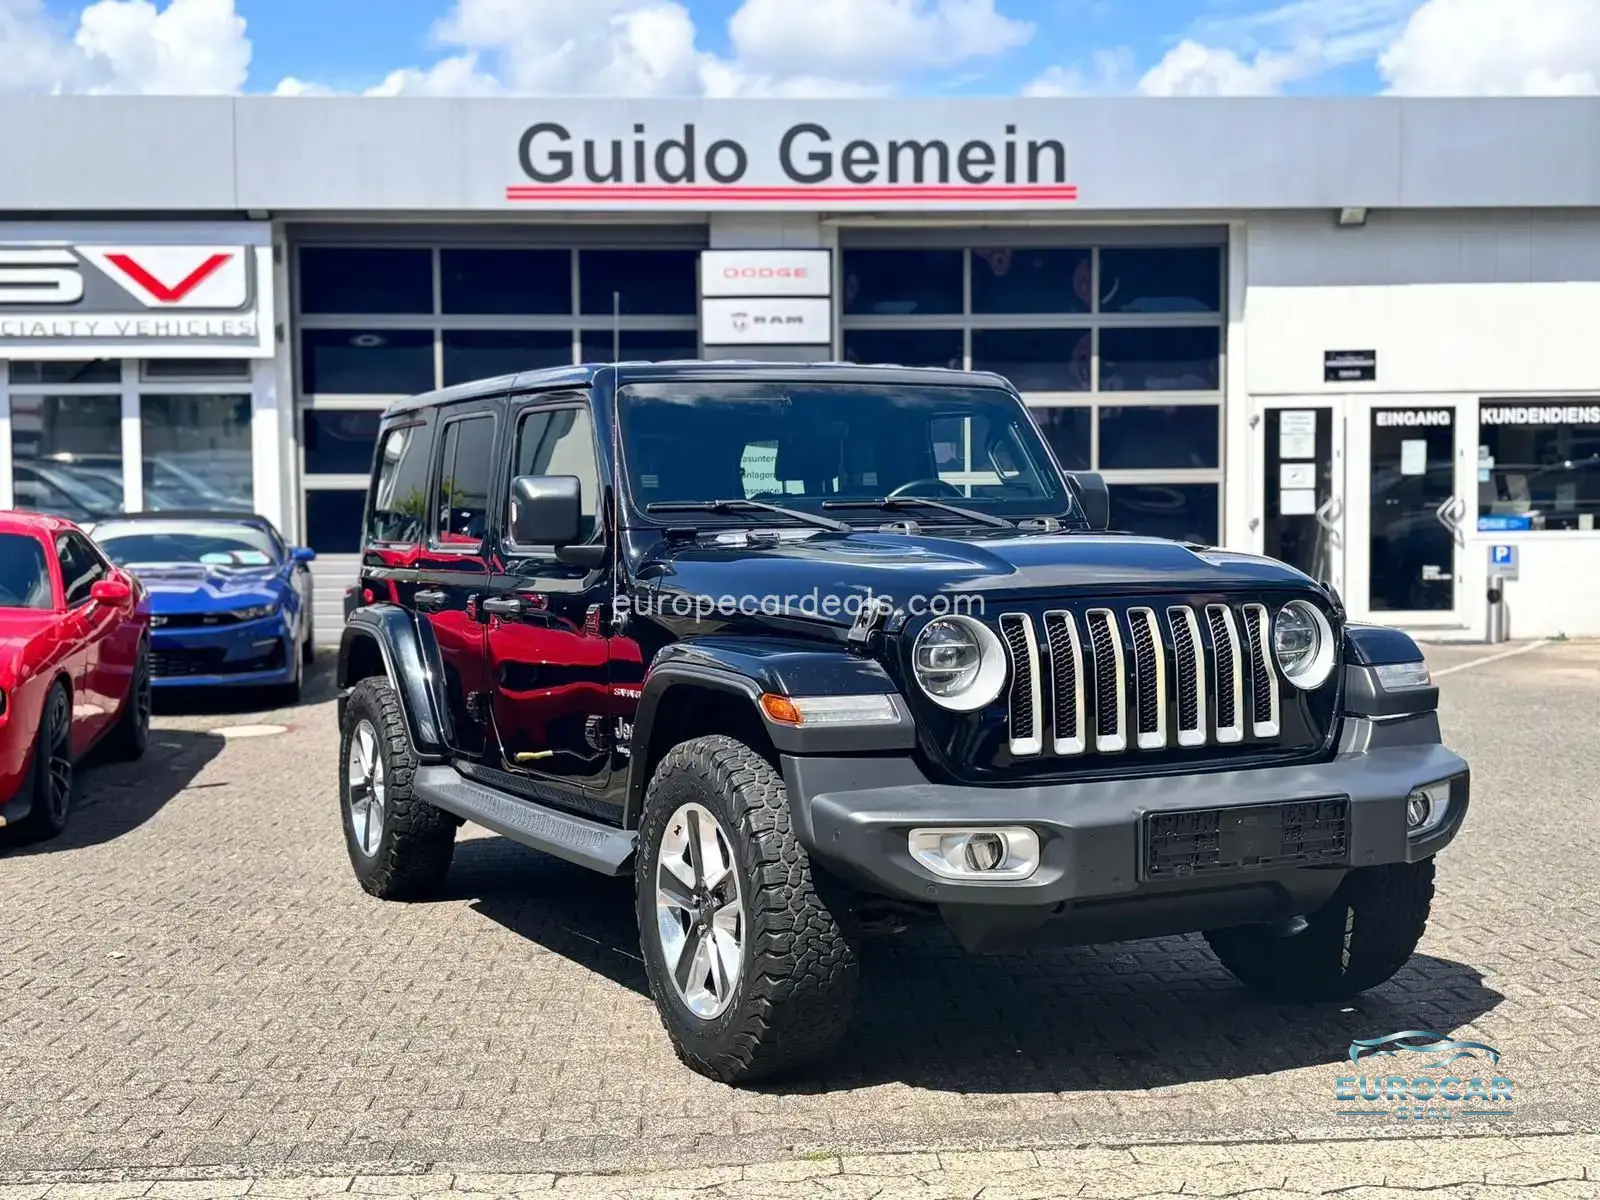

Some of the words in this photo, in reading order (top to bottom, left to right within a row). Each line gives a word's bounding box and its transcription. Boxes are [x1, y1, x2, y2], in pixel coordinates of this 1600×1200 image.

[518, 122, 748, 184] Guido
[779, 122, 1067, 184] Gemein
[723, 267, 808, 279] DODGE
[753, 315, 804, 325] RAM
[114, 320, 252, 336] VEHICLES
[1376, 411, 1450, 426] EINGANG
